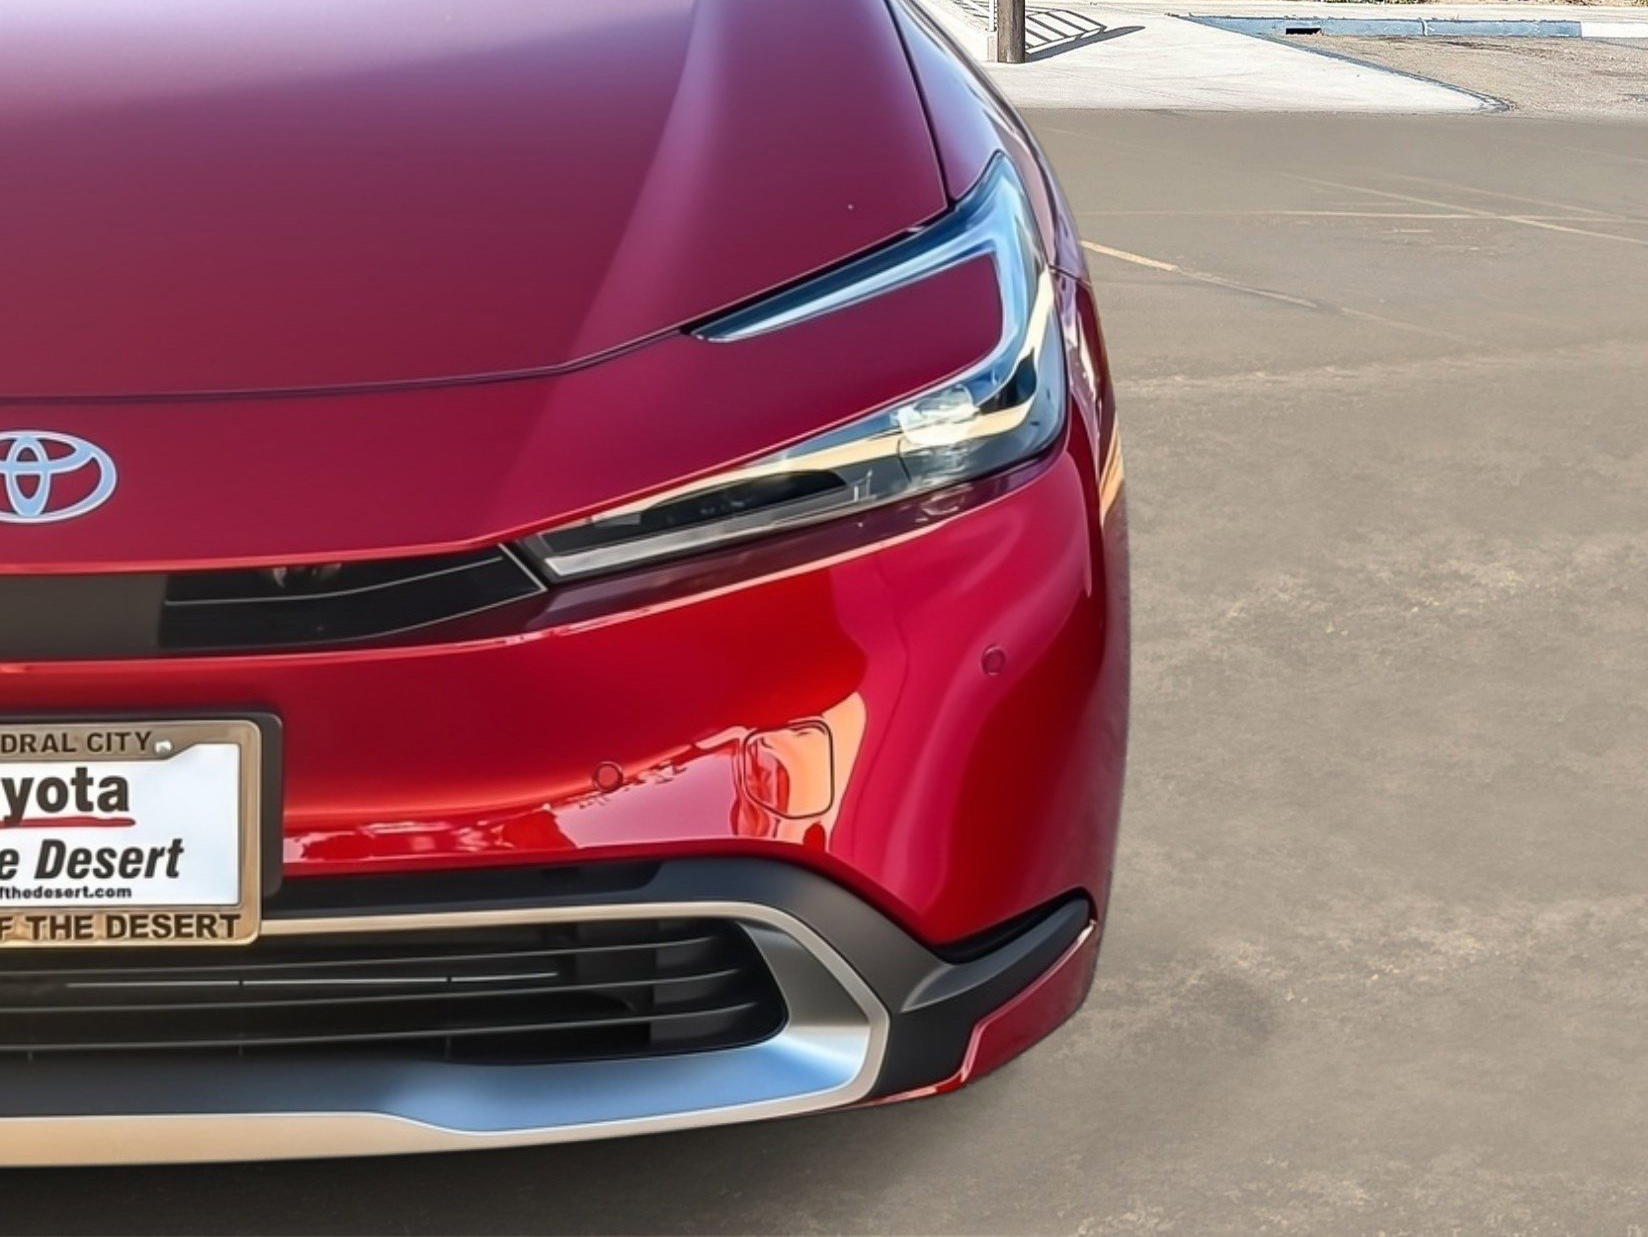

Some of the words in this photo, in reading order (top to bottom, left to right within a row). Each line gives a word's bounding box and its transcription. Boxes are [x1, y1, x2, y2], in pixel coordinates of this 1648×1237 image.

[86, 731, 152, 753] CITY
[33, 838, 185, 879] Desert
[25, 914, 94, 941] THE
[106, 912, 242, 940] DESERT
